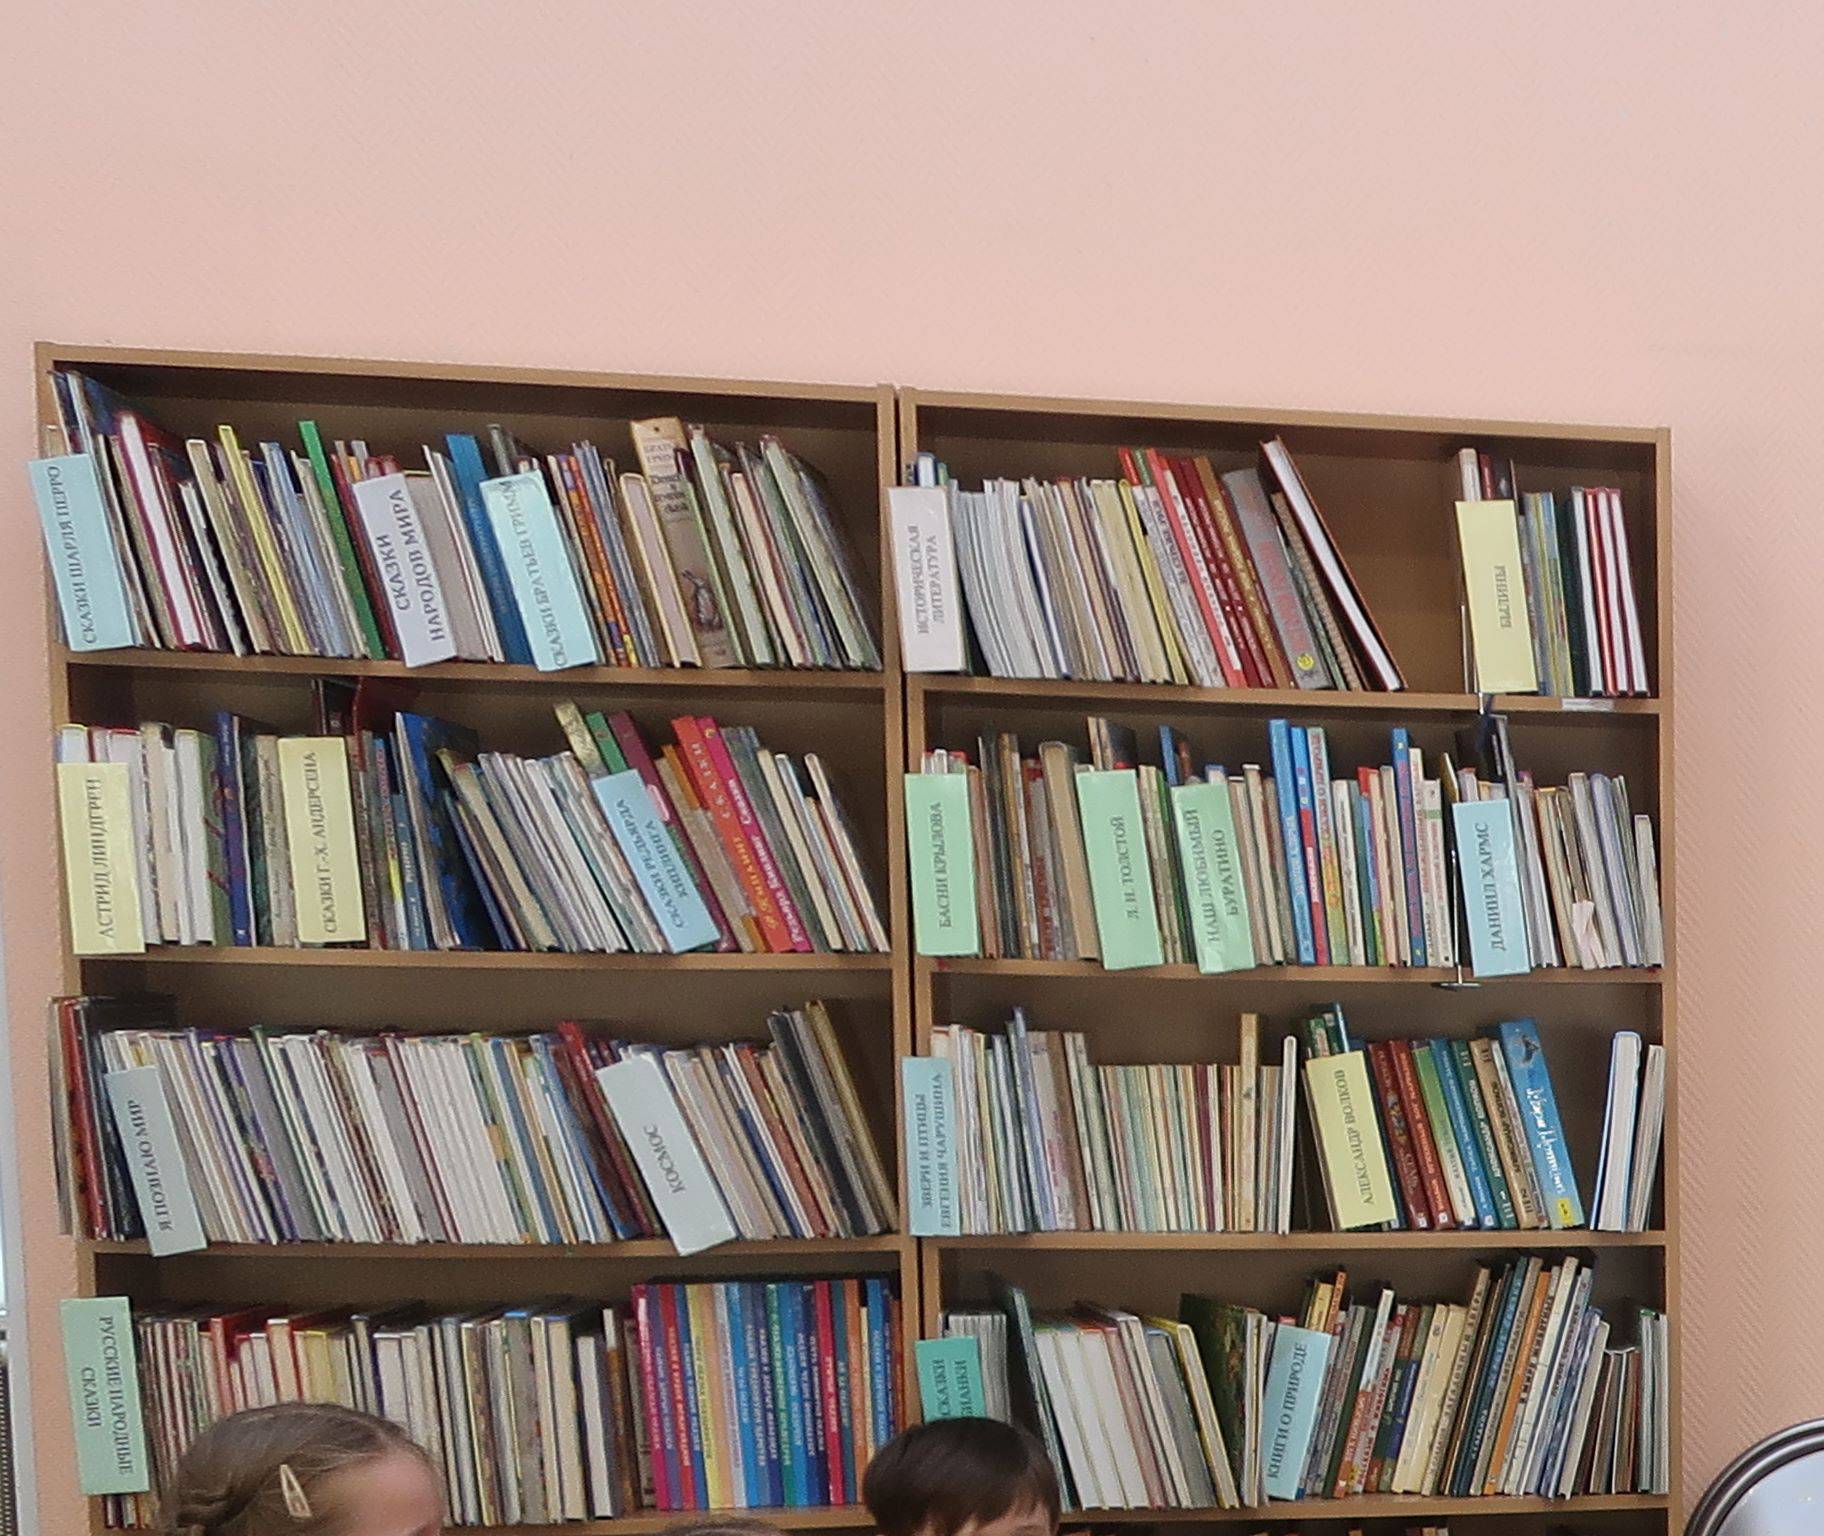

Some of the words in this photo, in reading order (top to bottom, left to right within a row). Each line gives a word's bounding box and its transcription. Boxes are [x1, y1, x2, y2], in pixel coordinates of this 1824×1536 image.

[60, 517, 86, 577] ШАРЛЯ
[389, 488, 418, 549] МИРА
[377, 533, 411, 612] СКАЗКИ
[408, 551, 446, 643] НАРОДОВ
[908, 524, 930, 634] ИСТОРИЧЕСКАЯ
[927, 534, 946, 624] ЛИТЕРАТУРА
[1494, 564, 1512, 628] БЫЛИНЫ
[71, 578, 97, 646] СКАЗКИ
[536, 607, 567, 669] СКАЗКИ
[86, 777, 109, 871] ЛИНДГРЕН
[302, 752, 323, 838] АНДЕРСЕНА
[930, 802, 947, 880] КРЫЛОВА
[1114, 815, 1135, 888] ТОЛСТОЙ
[1184, 807, 1211, 898] ЛЮБИМЫЙ
[1213, 829, 1238, 916] БУРАТИНО
[1476, 821, 1496, 879] ХАРМС
[95, 873, 117, 939] АСТРИД
[318, 876, 338, 933] СКАЗКИ
[657, 874, 686, 930] СКАЗКИ
[934, 882, 953, 928] БАСНИ
[1201, 900, 1220, 943] НАШ
[1486, 882, 1506, 951] ДАНИИЛ
[1335, 1069, 1355, 1126] ВОЛКОВ
[643, 1123, 686, 1194] КОСМОС
[1347, 1127, 1375, 1205] АЛЕКСАНДР
[100, 1315, 123, 1387] РУССКИЕ
[81, 1366, 101, 1428] СКАЗКИ
[109, 1388, 134, 1476] НАРОДНЫЕ
[1268, 1431, 1287, 1480] КНИГИ
[1284, 1342, 1309, 1411] ПРИРОДЕ
